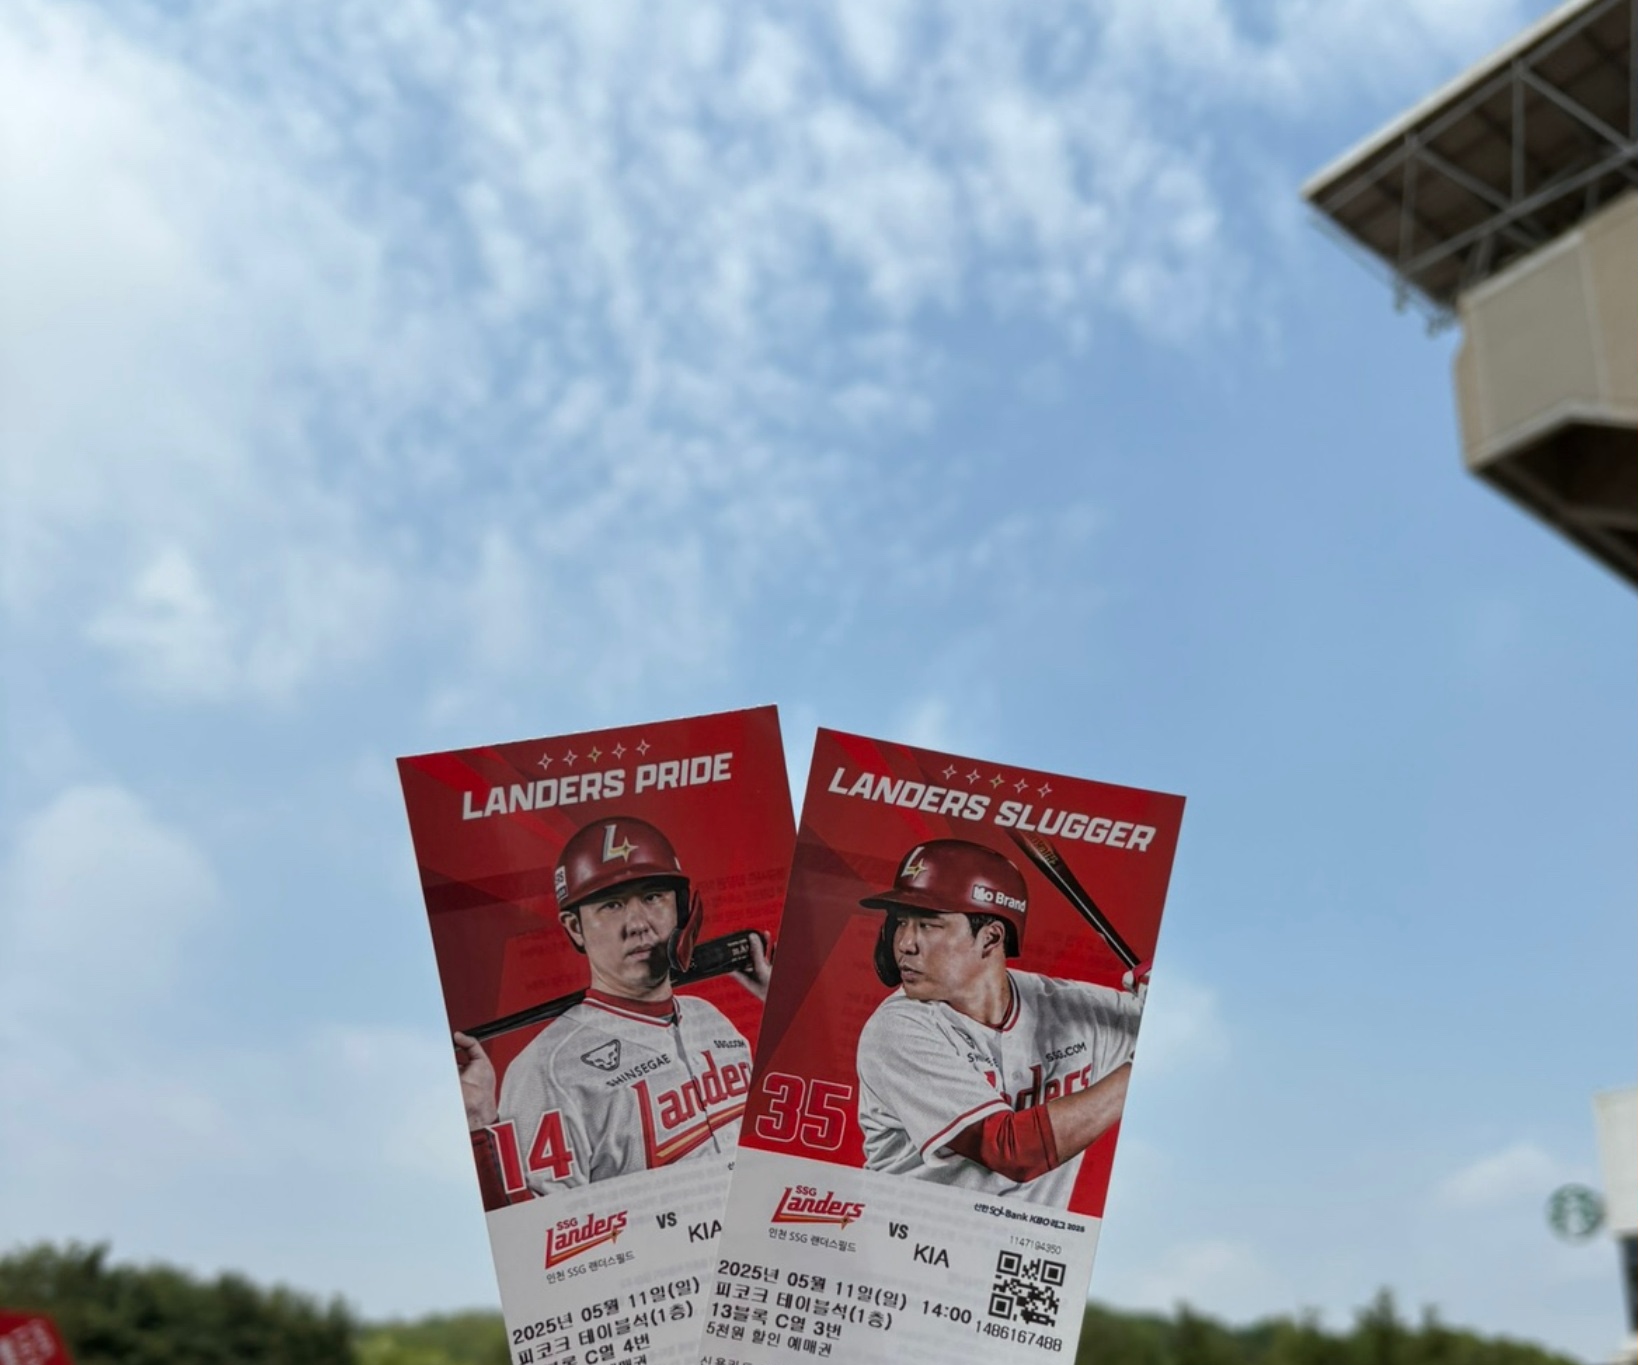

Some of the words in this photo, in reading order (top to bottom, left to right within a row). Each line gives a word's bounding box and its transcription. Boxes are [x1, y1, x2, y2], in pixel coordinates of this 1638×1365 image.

[462, 768, 625, 820] LANDERS
[635, 752, 733, 794] PRIDE
[827, 767, 990, 821] LANDERS
[994, 800, 1156, 852] SLUGGER
[995, 891, 1027, 913] Brand
[606, 1053, 671, 1088] SHINSEGAE
[1045, 1041, 1087, 1063] SSG.COM
[755, 1071, 853, 1151] 35
[485, 1108, 574, 1194] 14
[771, 1187, 866, 1226] Landers
[795, 1185, 817, 1197] SSG
[545, 1210, 628, 1270] Landers
[556, 1217, 579, 1230] SSG
[688, 1219, 722, 1243] KIA
[768, 1227, 787, 1240] 인천
[789, 1231, 808, 1244] SSG
[810, 1235, 857, 1253] 랜더스필드
[546, 1272, 565, 1285] 인천
[567, 1266, 587, 1279] SSG
[589, 1250, 635, 1272] 랜더스필드
[913, 1243, 950, 1268] KIA
[512, 1312, 573, 1345] 2025년
[581, 1298, 620, 1322] 05월
[628, 1276, 700, 1308] 11일(일)
[715, 1282, 769, 1304] 피코크
[776, 1292, 893, 1331] 테이블석(1층)
[718, 1259, 780, 1284] 2025년
[787, 1271, 826, 1293] 05월
[835, 1281, 907, 1311] 11일(일)
[922, 1300, 973, 1324] 14:00
[579, 1300, 693, 1346] 테이블석(1층)
[706, 1321, 746, 1341] 5천원
[751, 1328, 781, 1347] 할인
[787, 1336, 832, 1359] 예매권
[711, 1302, 769, 1325] 13블록
[775, 1314, 806, 1333] C열
[813, 1321, 842, 1341] 3번
[976, 1320, 1063, 1352] 1486167488
[584, 1343, 615, 1365] C열
[623, 1333, 651, 1353] 4번
